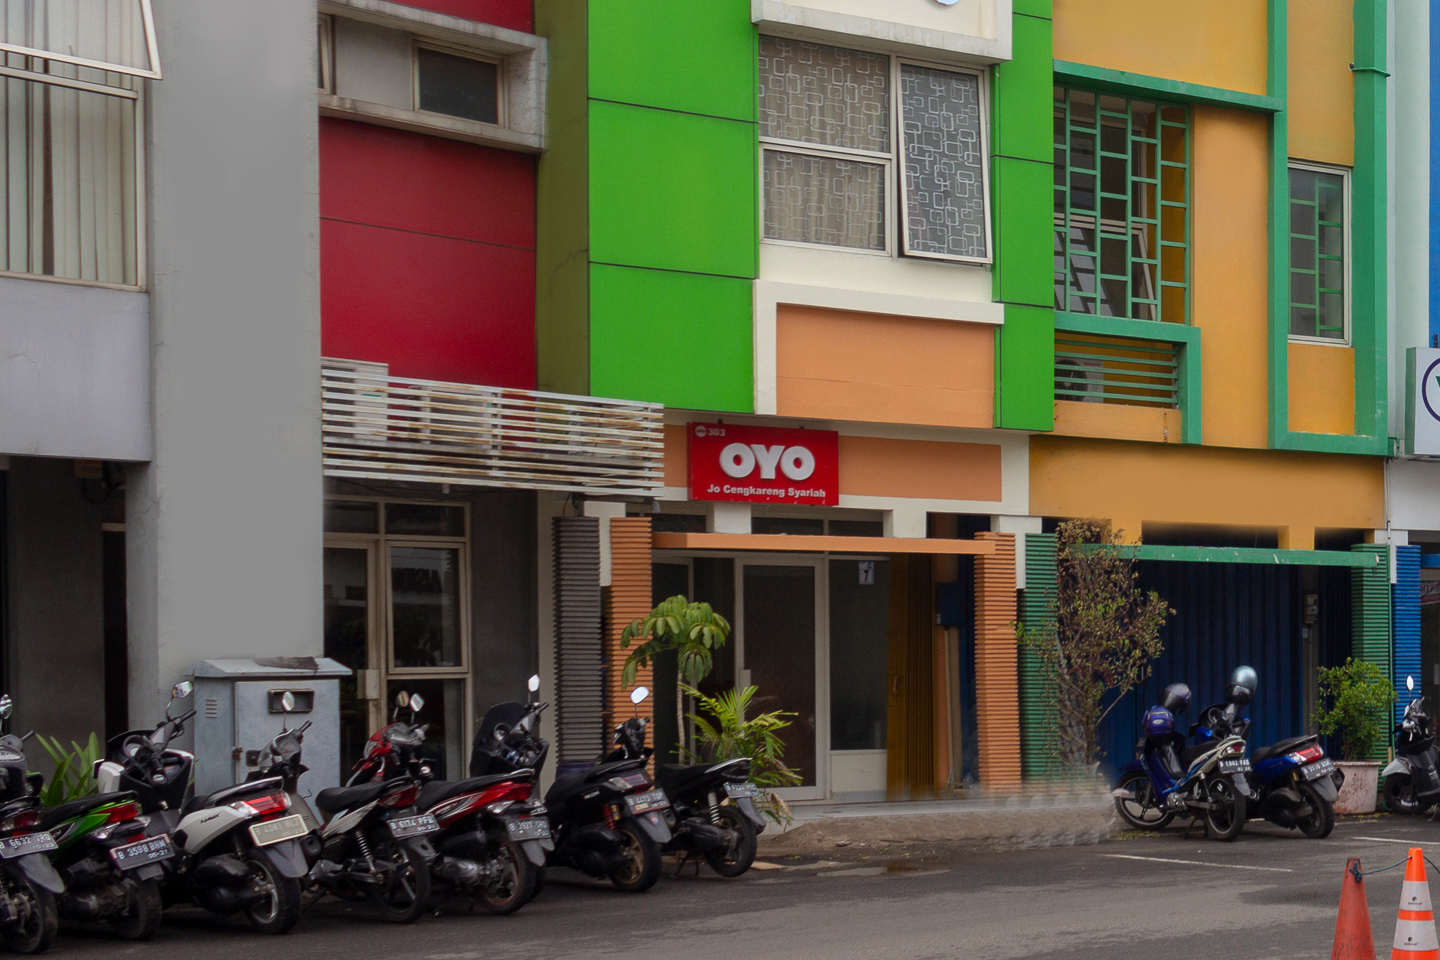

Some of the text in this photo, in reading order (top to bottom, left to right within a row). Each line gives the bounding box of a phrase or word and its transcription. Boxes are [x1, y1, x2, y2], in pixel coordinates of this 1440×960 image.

[708, 428, 725, 436] 303
[719, 442, 815, 481] OYO
[707, 484, 826, 498] Jo Cengkareng Syariah
[9, 836, 32, 846] 6632
[117, 851, 125, 859] B
[127, 845, 149, 856] 3598
